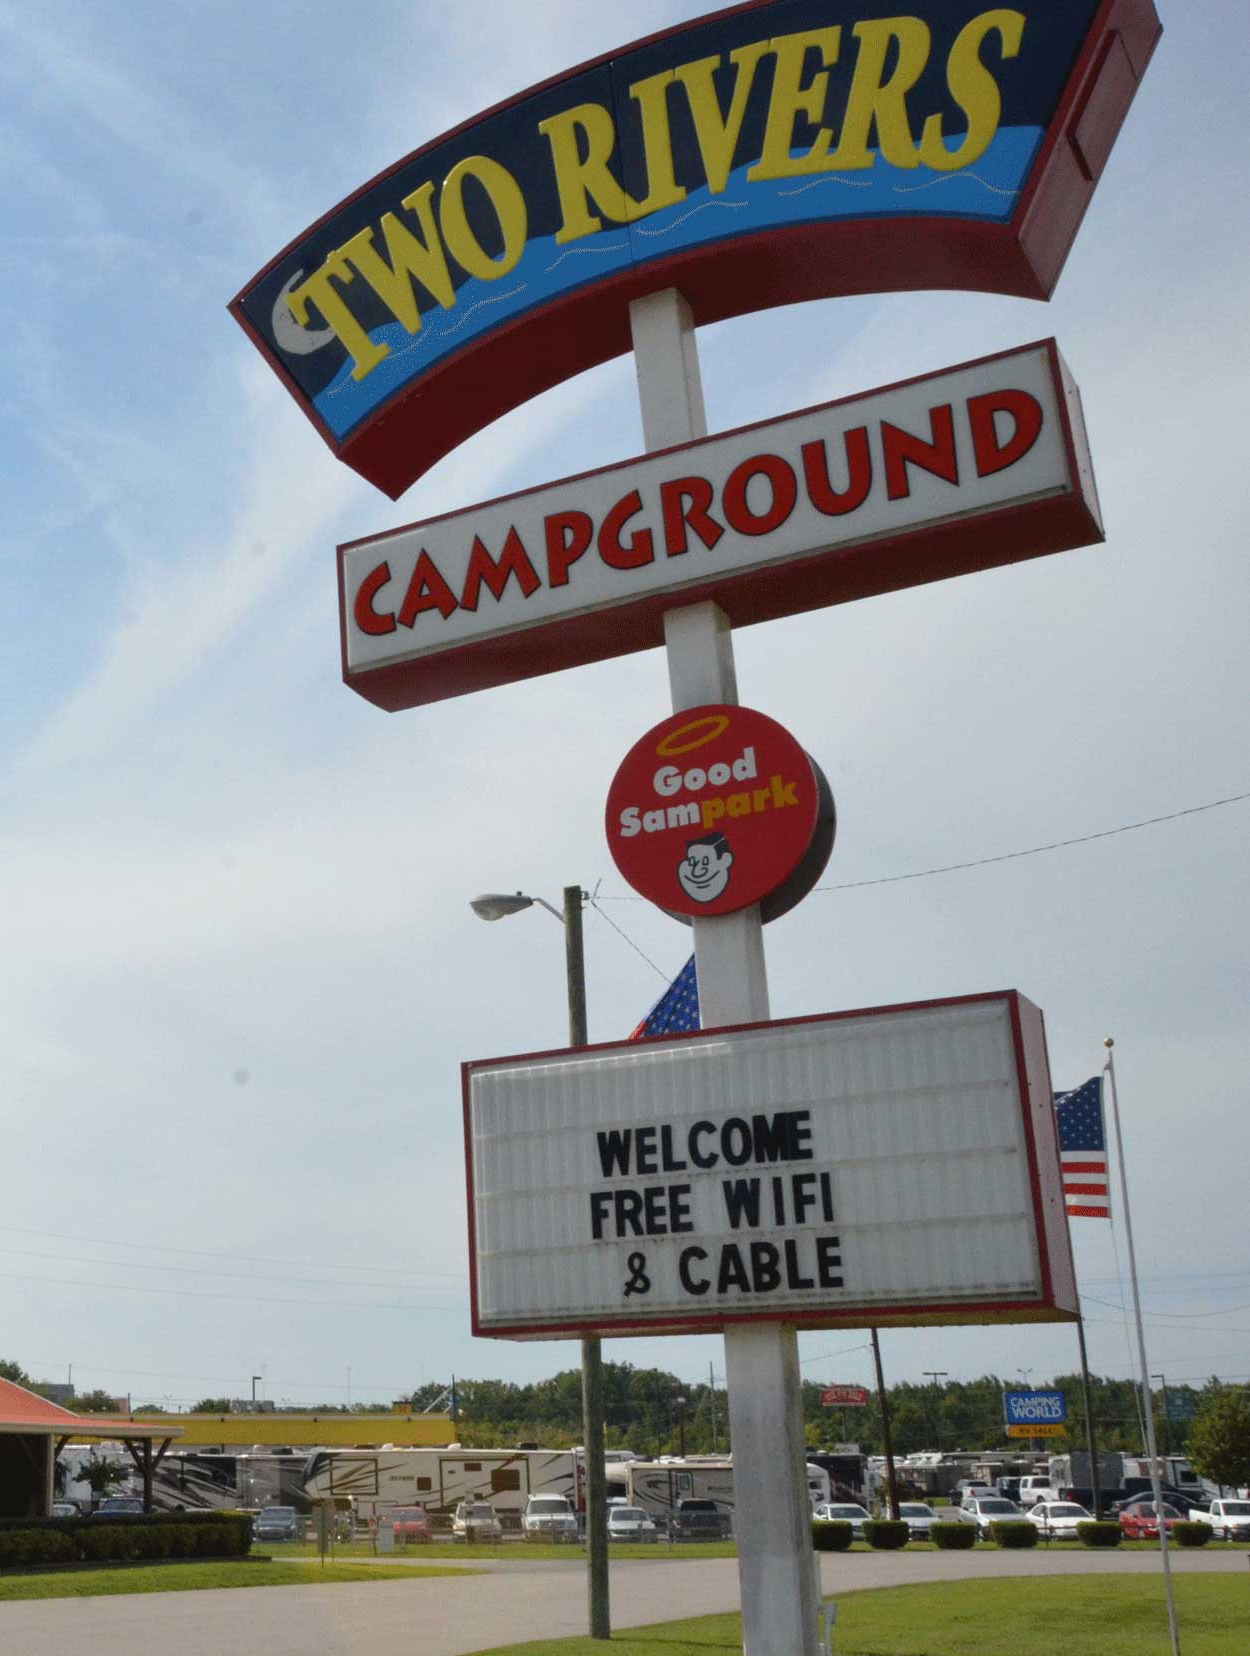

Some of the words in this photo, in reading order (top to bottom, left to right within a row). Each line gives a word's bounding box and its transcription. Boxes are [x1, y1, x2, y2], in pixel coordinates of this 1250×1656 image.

[285, 154, 528, 382] TWO
[538, 8, 1027, 245] RIVERS
[353, 387, 1044, 636] CAMPGROUND
[653, 746, 758, 797] Good
[597, 1110, 814, 1178] WELCOME
[590, 1184, 694, 1240] FREE
[722, 1172, 834, 1229] WIFI
[623, 1252, 651, 1297] &
[679, 1236, 844, 1296] CABLE
[1010, 1396, 1061, 1407] CAMPING
[1011, 1406, 1063, 1418] WORLD
